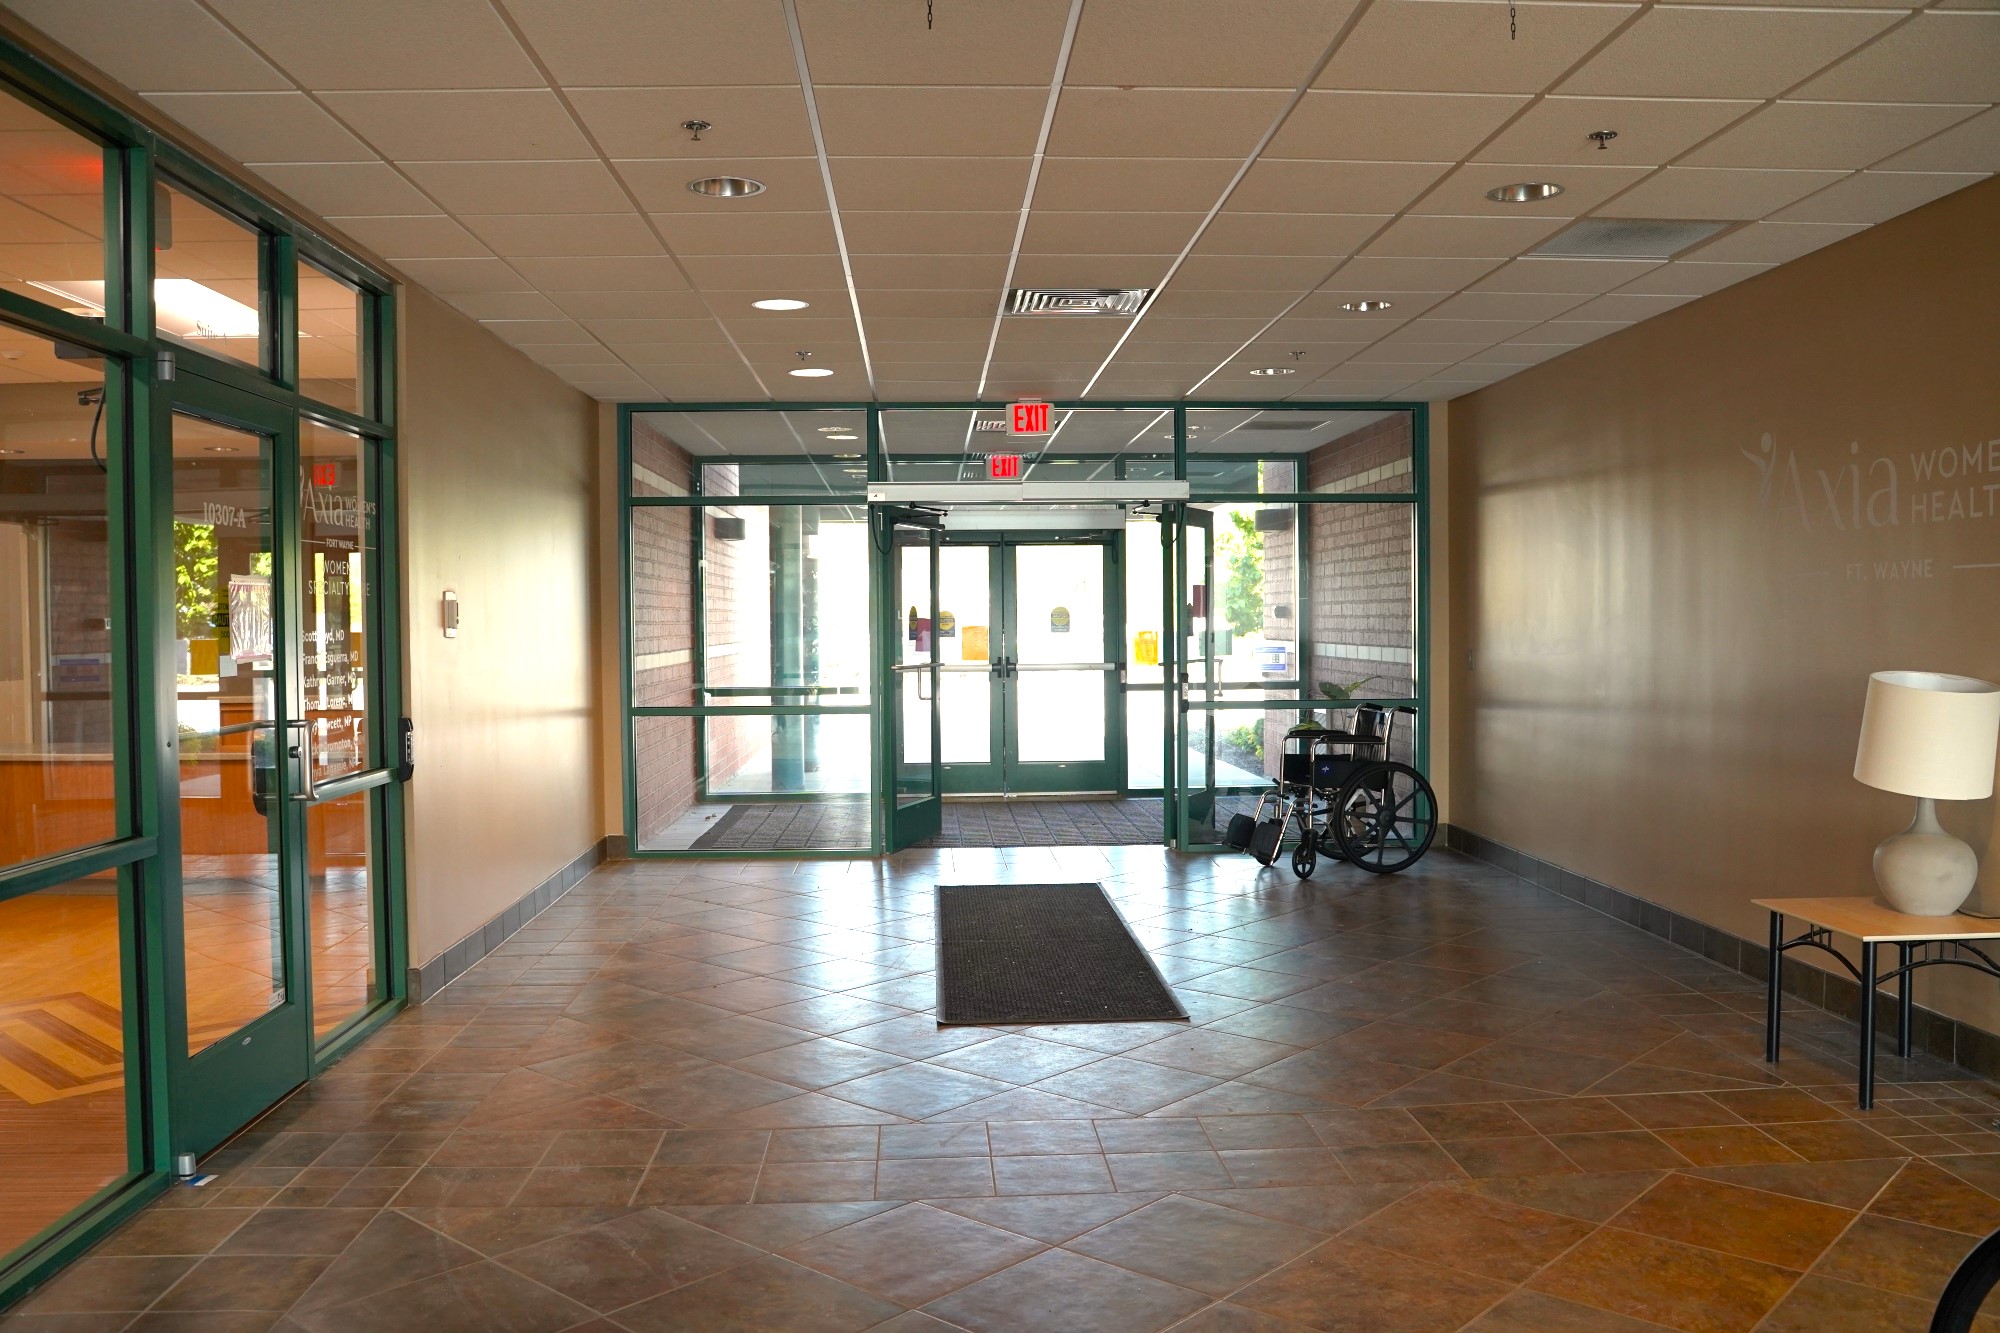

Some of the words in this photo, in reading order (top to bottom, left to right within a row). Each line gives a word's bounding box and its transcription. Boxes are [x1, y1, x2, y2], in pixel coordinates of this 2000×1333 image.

[1013, 404, 1049, 432] EXIT
[992, 456, 1019, 478] EXIT
[303, 478, 344, 527] Axia
[345, 496, 376, 515] WOEN'S
[203, 502, 247, 529] 10307-A
[345, 514, 371, 530] HEATH
[326, 538, 338, 549] FORT
[339, 539, 354, 550] WAYNE
[1873, 558, 1934, 580] WAYNE
[335, 629, 345, 642] MD
[350, 650, 359, 662] MD
